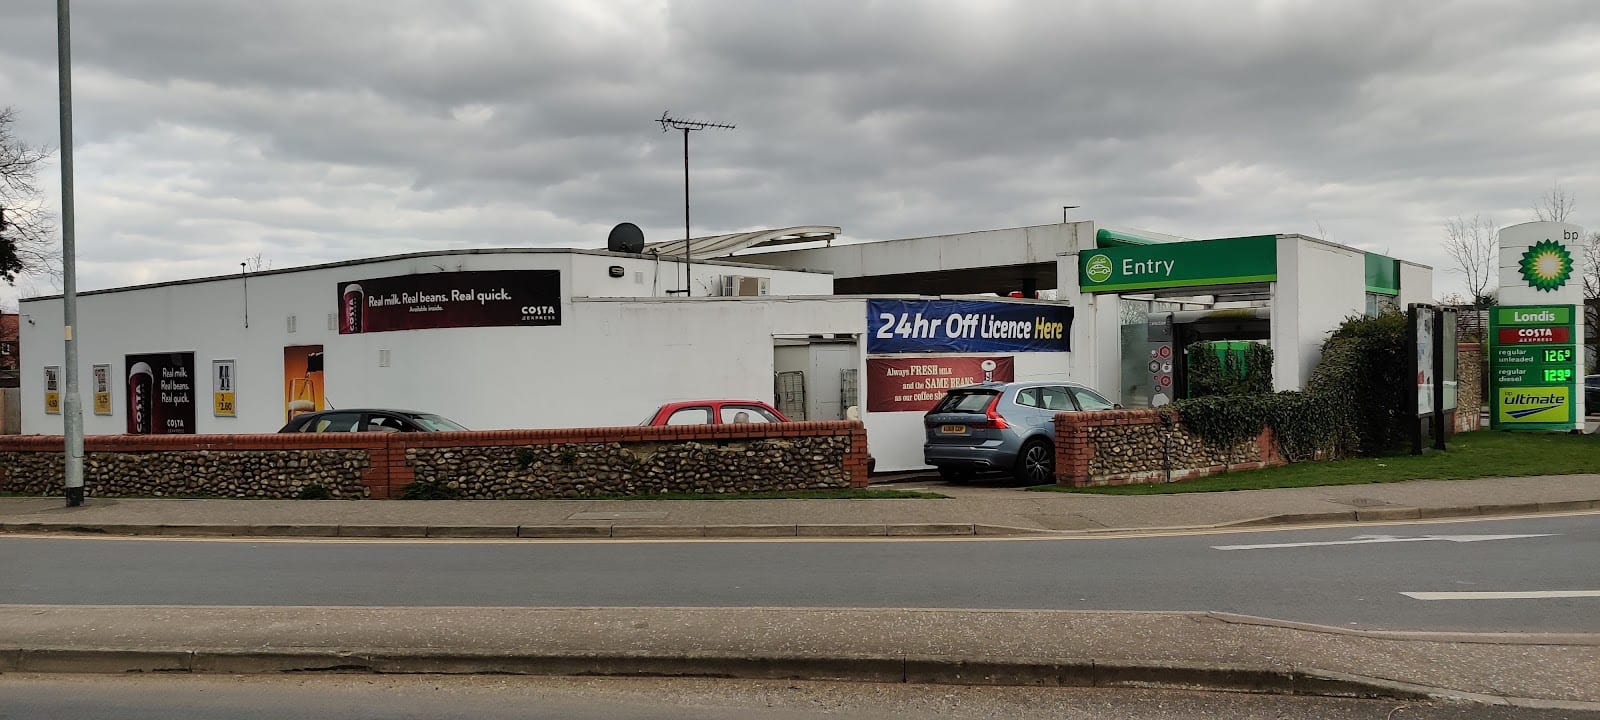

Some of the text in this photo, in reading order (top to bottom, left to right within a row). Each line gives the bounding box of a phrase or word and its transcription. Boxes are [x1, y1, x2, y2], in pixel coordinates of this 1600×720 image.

[1563, 229, 1579, 243] bp
[1122, 258, 1175, 276] Entry
[368, 288, 512, 307] Real milk. Real beans. Real quick.
[521, 306, 556, 315] COSTA
[1514, 310, 1556, 322] Londis
[876, 313, 1063, 340] 24hr Off Licence Here
[1518, 328, 1553, 337] COSTA
[1498, 348, 1527, 356] regular
[162, 367, 188, 378] Real milk.
[886, 365, 953, 377] Always FRESH MILK
[1498, 368, 1527, 376] regular
[161, 380, 190, 391] Real beans.
[902, 382, 914, 390] and
[914, 381, 925, 390] the
[925, 378, 949, 389] SAME
[161, 392, 190, 407] Real quick.
[913, 391, 934, 401] coffee
[1504, 394, 1565, 405] ultimate
[167, 419, 184, 428] COSTA
